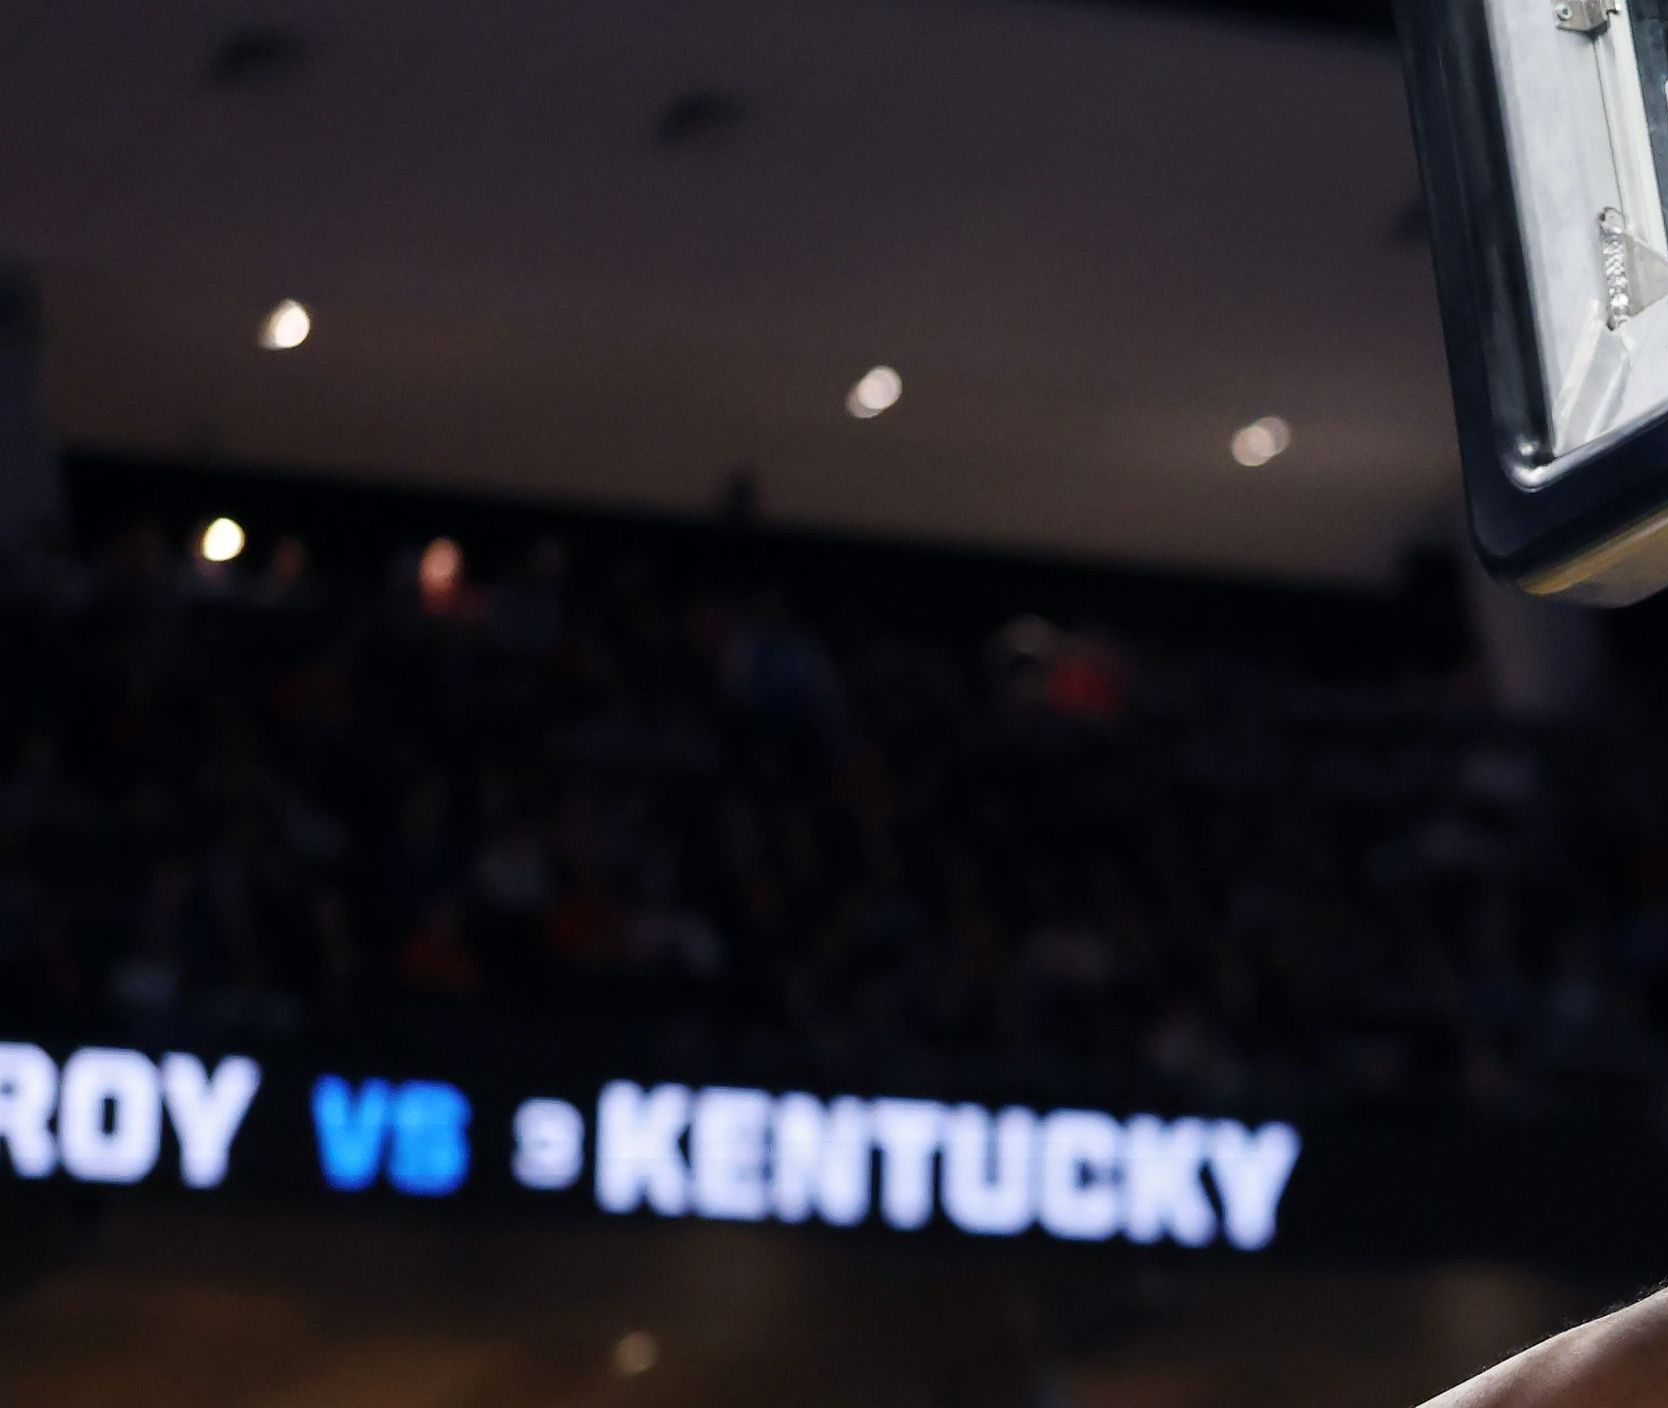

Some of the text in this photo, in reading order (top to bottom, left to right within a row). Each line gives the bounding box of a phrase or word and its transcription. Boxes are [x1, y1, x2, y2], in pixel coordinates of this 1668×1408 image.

[0, 1040, 261, 1189] ROY
[312, 1078, 471, 1193] VS
[596, 1080, 1300, 1250] KENTUCKY
